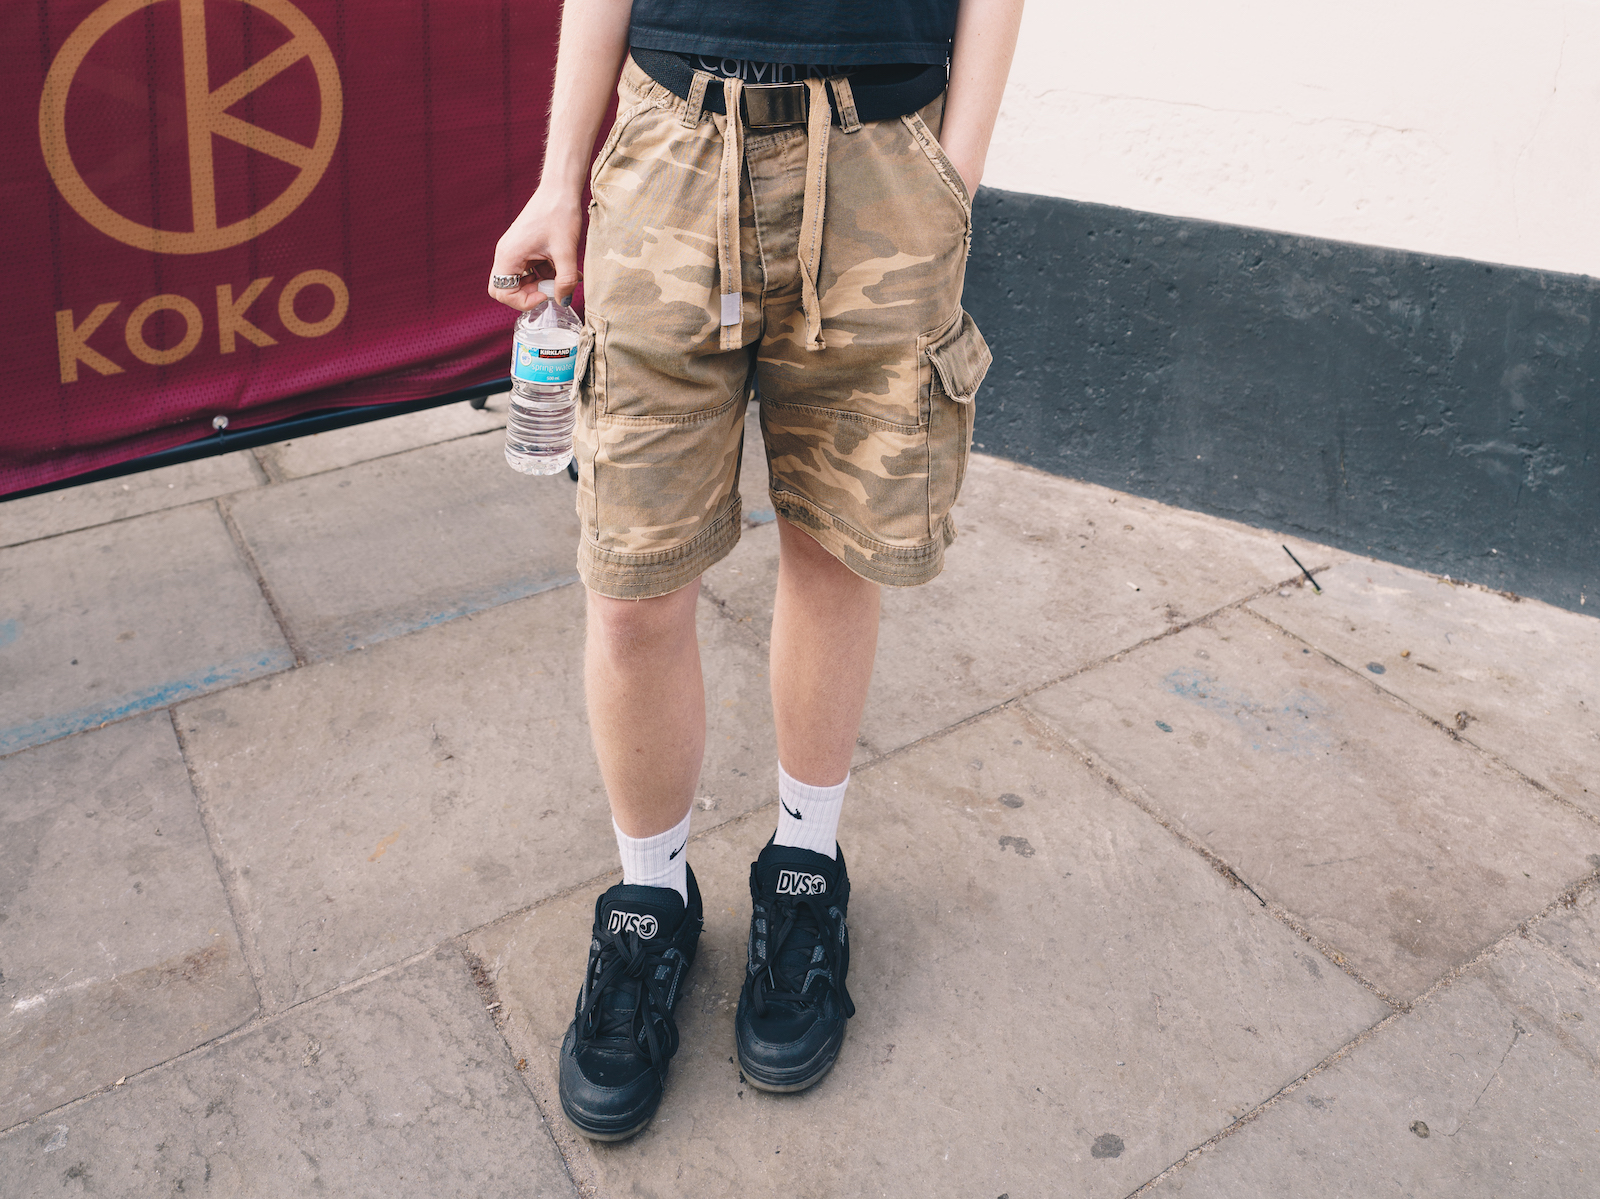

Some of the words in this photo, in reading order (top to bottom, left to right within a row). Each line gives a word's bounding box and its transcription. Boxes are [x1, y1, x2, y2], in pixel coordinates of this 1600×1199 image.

[55, 268, 350, 384] KOKO
[539, 348, 570, 356] KIRKLAND
[531, 363, 554, 374] spring
[776, 870, 811, 895] DVS
